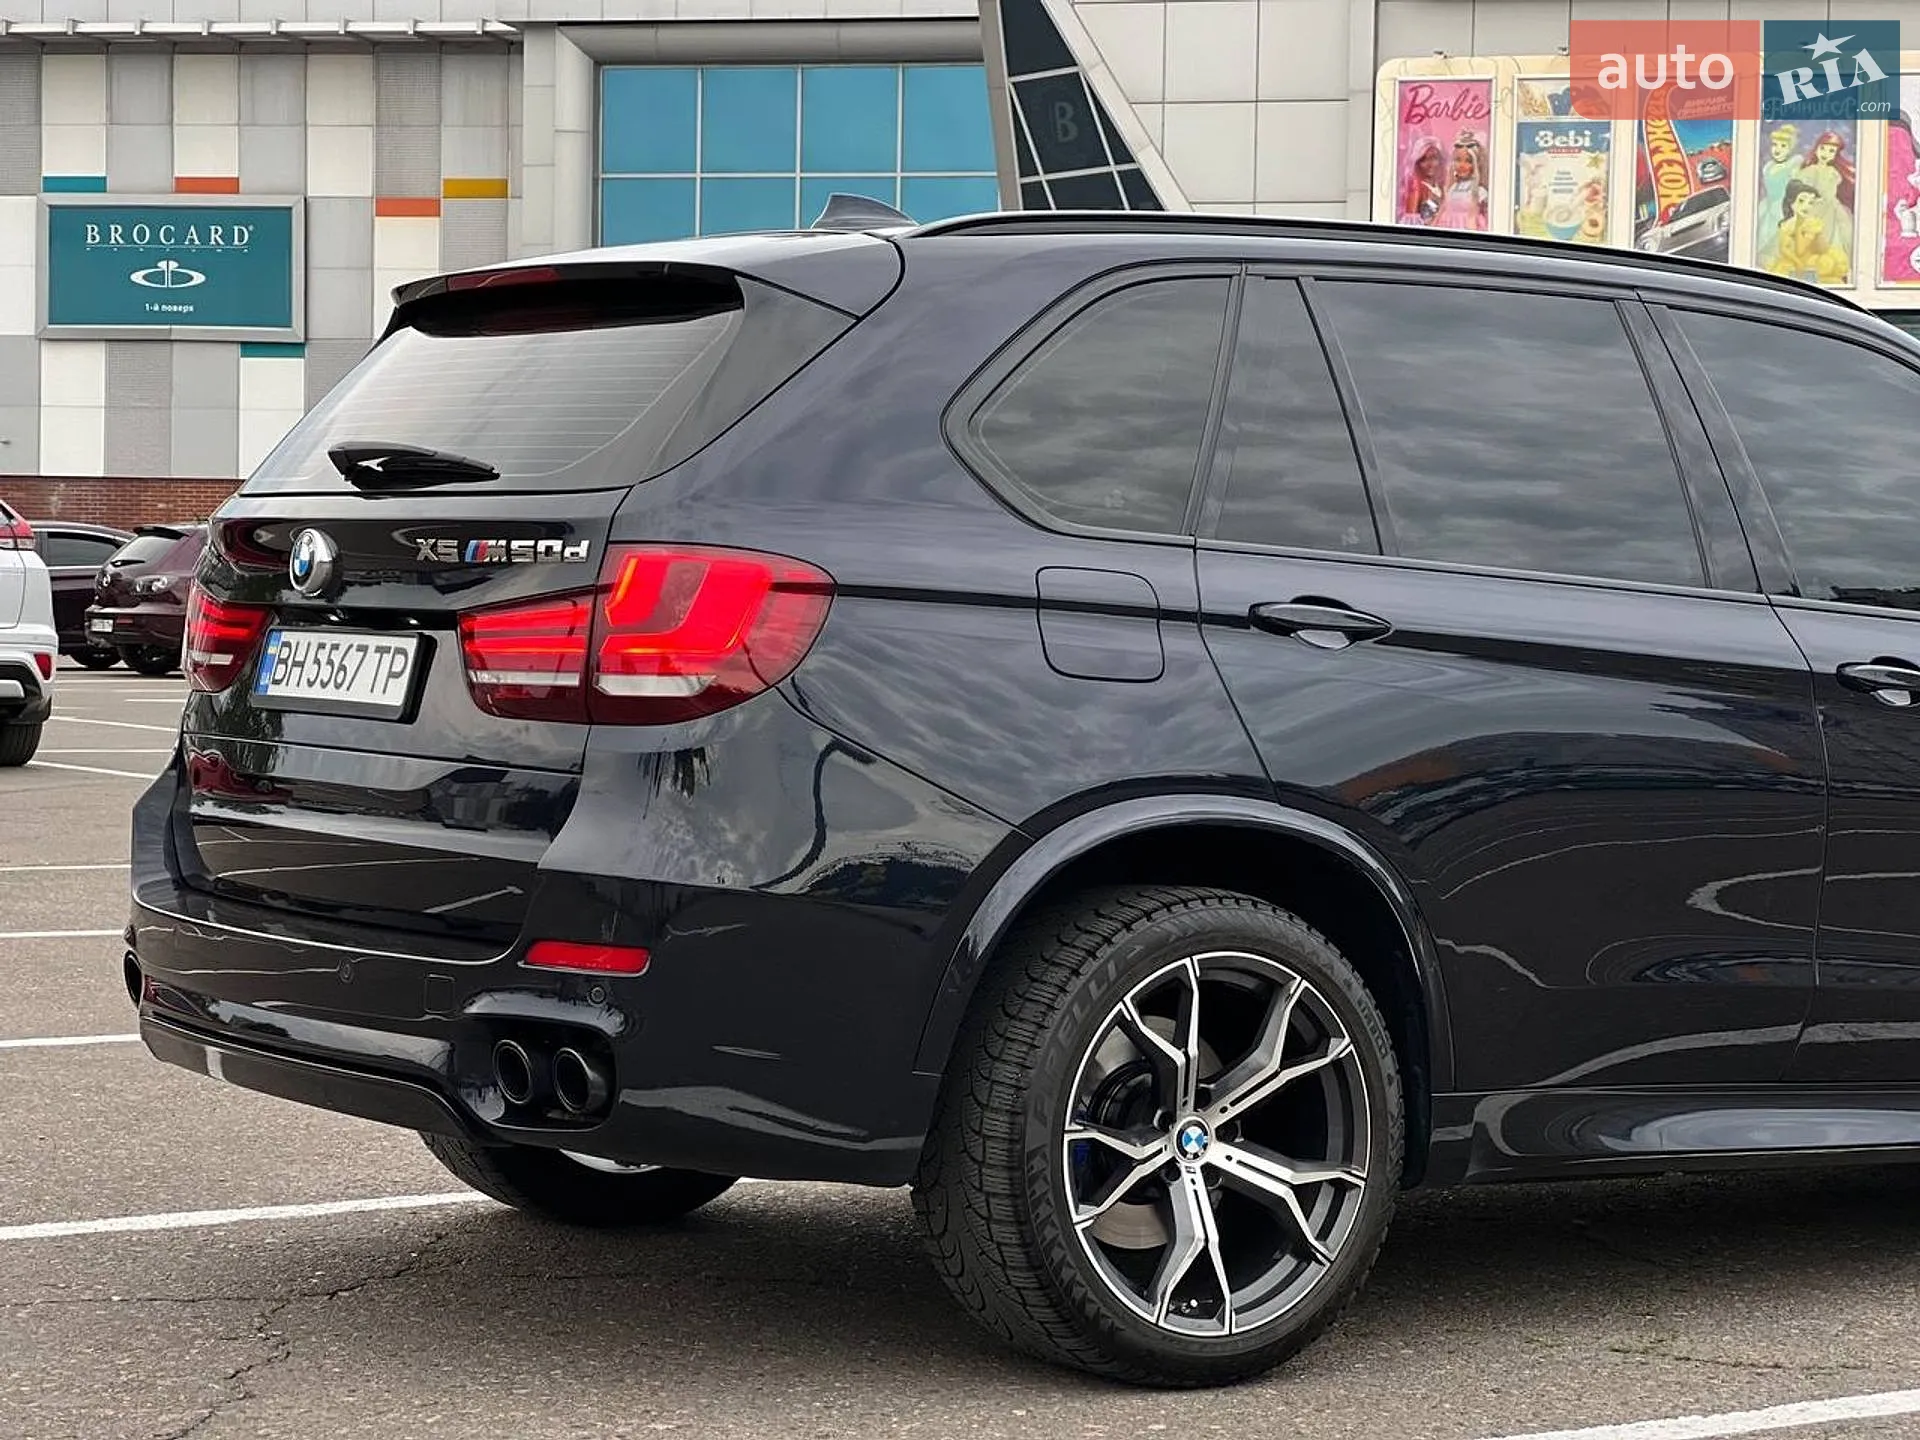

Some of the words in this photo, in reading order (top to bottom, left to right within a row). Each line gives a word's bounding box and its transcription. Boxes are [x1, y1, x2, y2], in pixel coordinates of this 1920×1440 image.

[1404, 84, 1491, 124] Barbie
[1535, 129, 1592, 148] Bebi
[86, 223, 250, 246] BROCARD
[415, 538, 459, 562] X5
[272, 641, 307, 686] BH
[307, 642, 368, 690] 5567
[371, 646, 408, 694] TP
